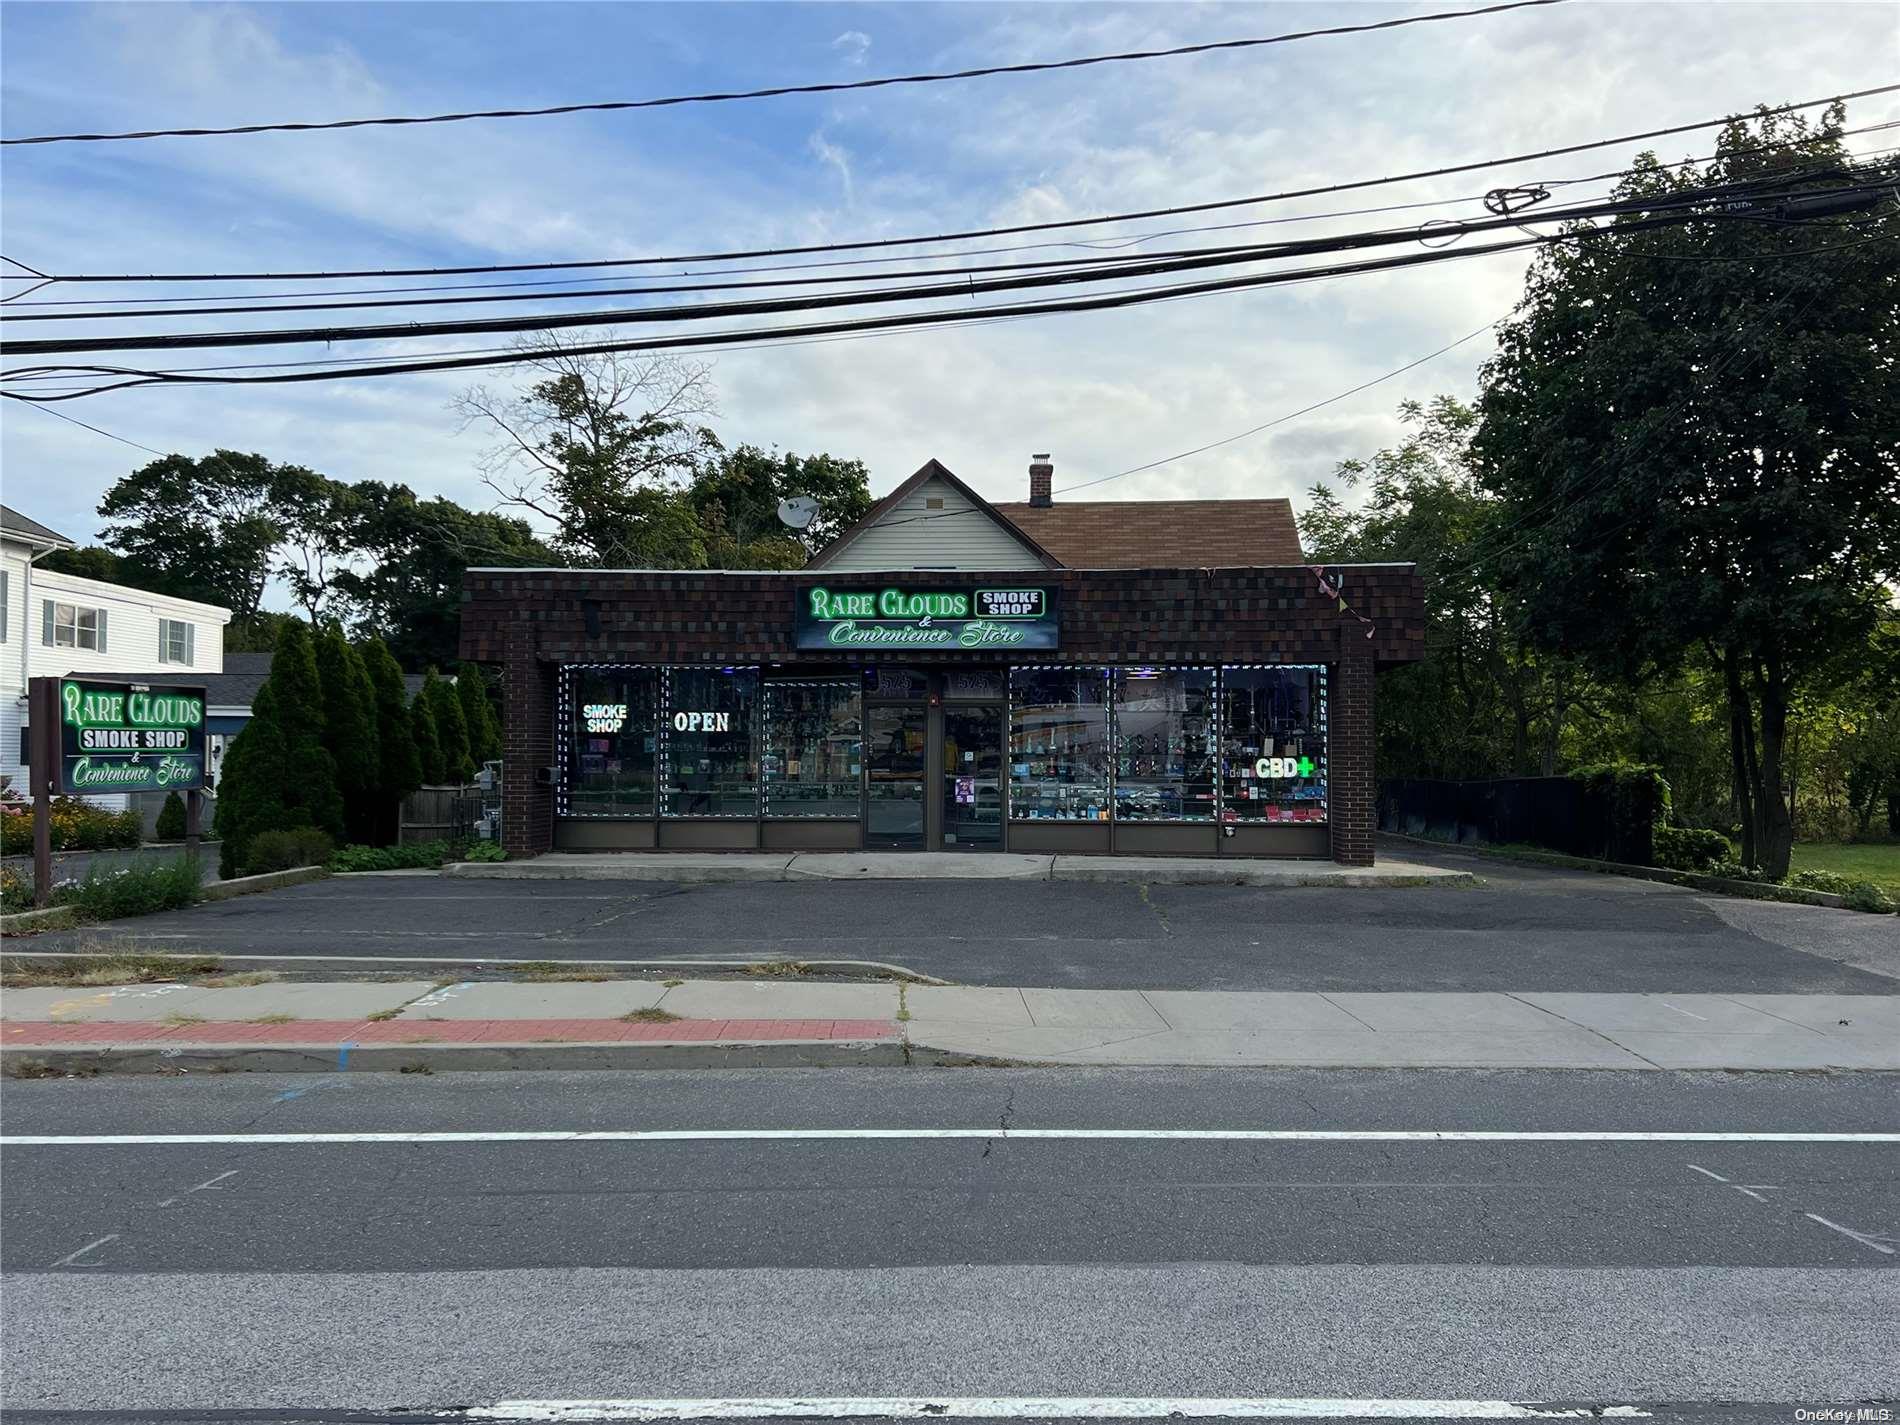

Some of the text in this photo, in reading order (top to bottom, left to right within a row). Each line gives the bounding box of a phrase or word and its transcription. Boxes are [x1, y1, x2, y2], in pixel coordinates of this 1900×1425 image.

[811, 589, 968, 617] RARE CLOUDS
[982, 592, 1039, 603] SMOKE
[988, 604, 1032, 615] SHOP
[918, 615, 931, 627] &
[829, 620, 1023, 647] Convenience Store
[63, 684, 202, 726] RARE CLOUDS
[583, 704, 627, 719] SMOKE
[587, 719, 622, 733] SHOP
[674, 712, 729, 732] OPEN
[84, 730, 185, 748] SMOKE SHOP
[131, 751, 140, 763] &
[73, 756, 193, 785] Convenience Store
